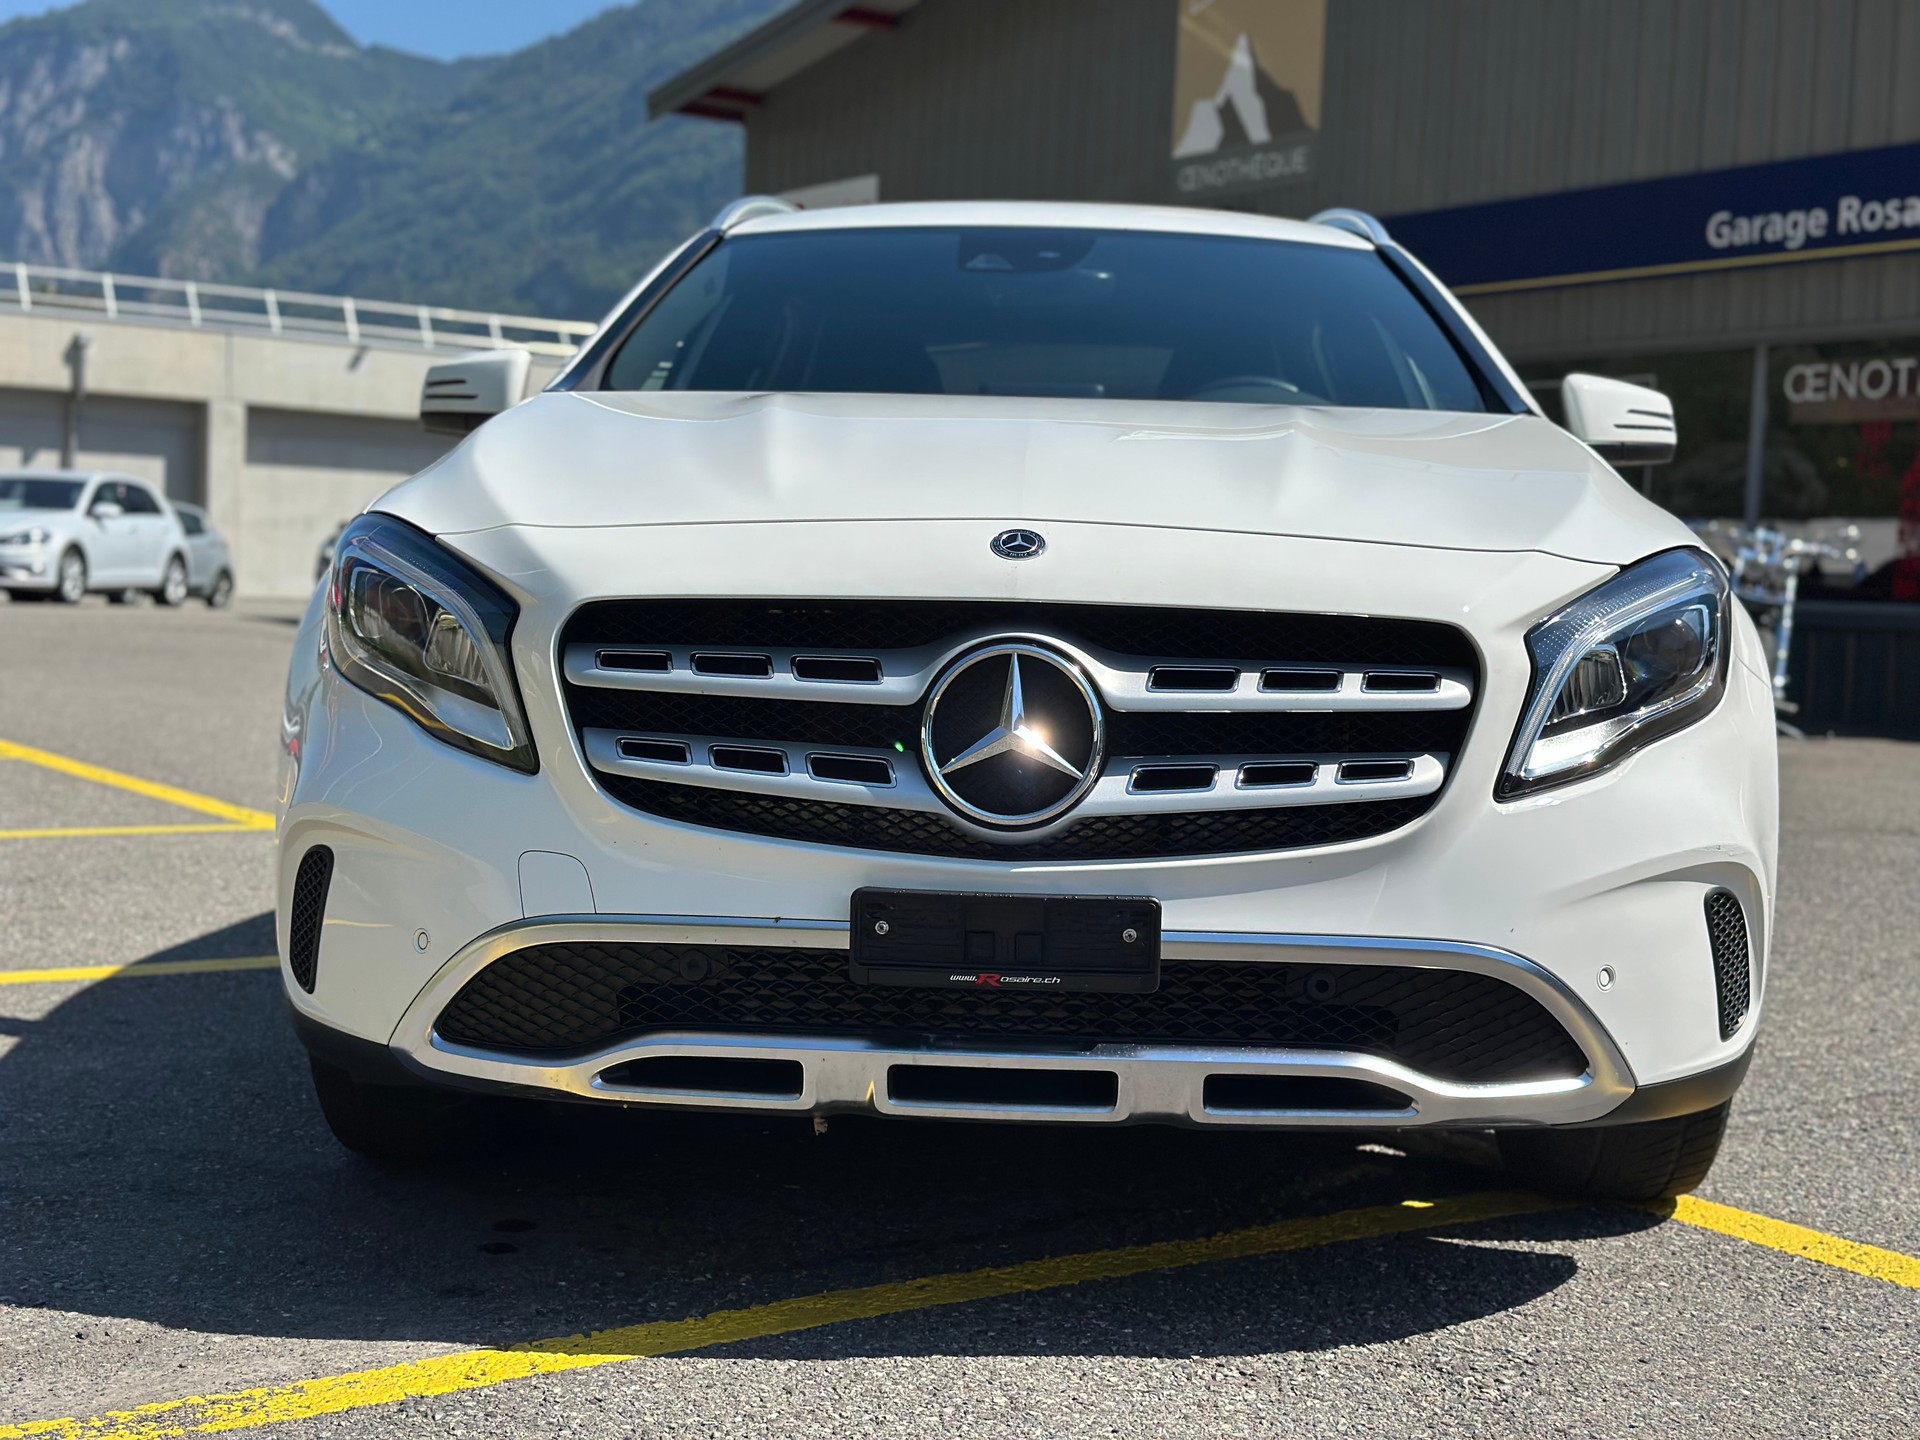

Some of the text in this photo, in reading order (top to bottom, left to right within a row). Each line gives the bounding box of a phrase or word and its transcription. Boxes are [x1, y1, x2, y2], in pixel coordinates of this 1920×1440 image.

[1705, 208, 1829, 250] Garage
[1782, 358, 1920, 403] ŒNOT
[950, 973, 1061, 988] www.Rosaire.ch
